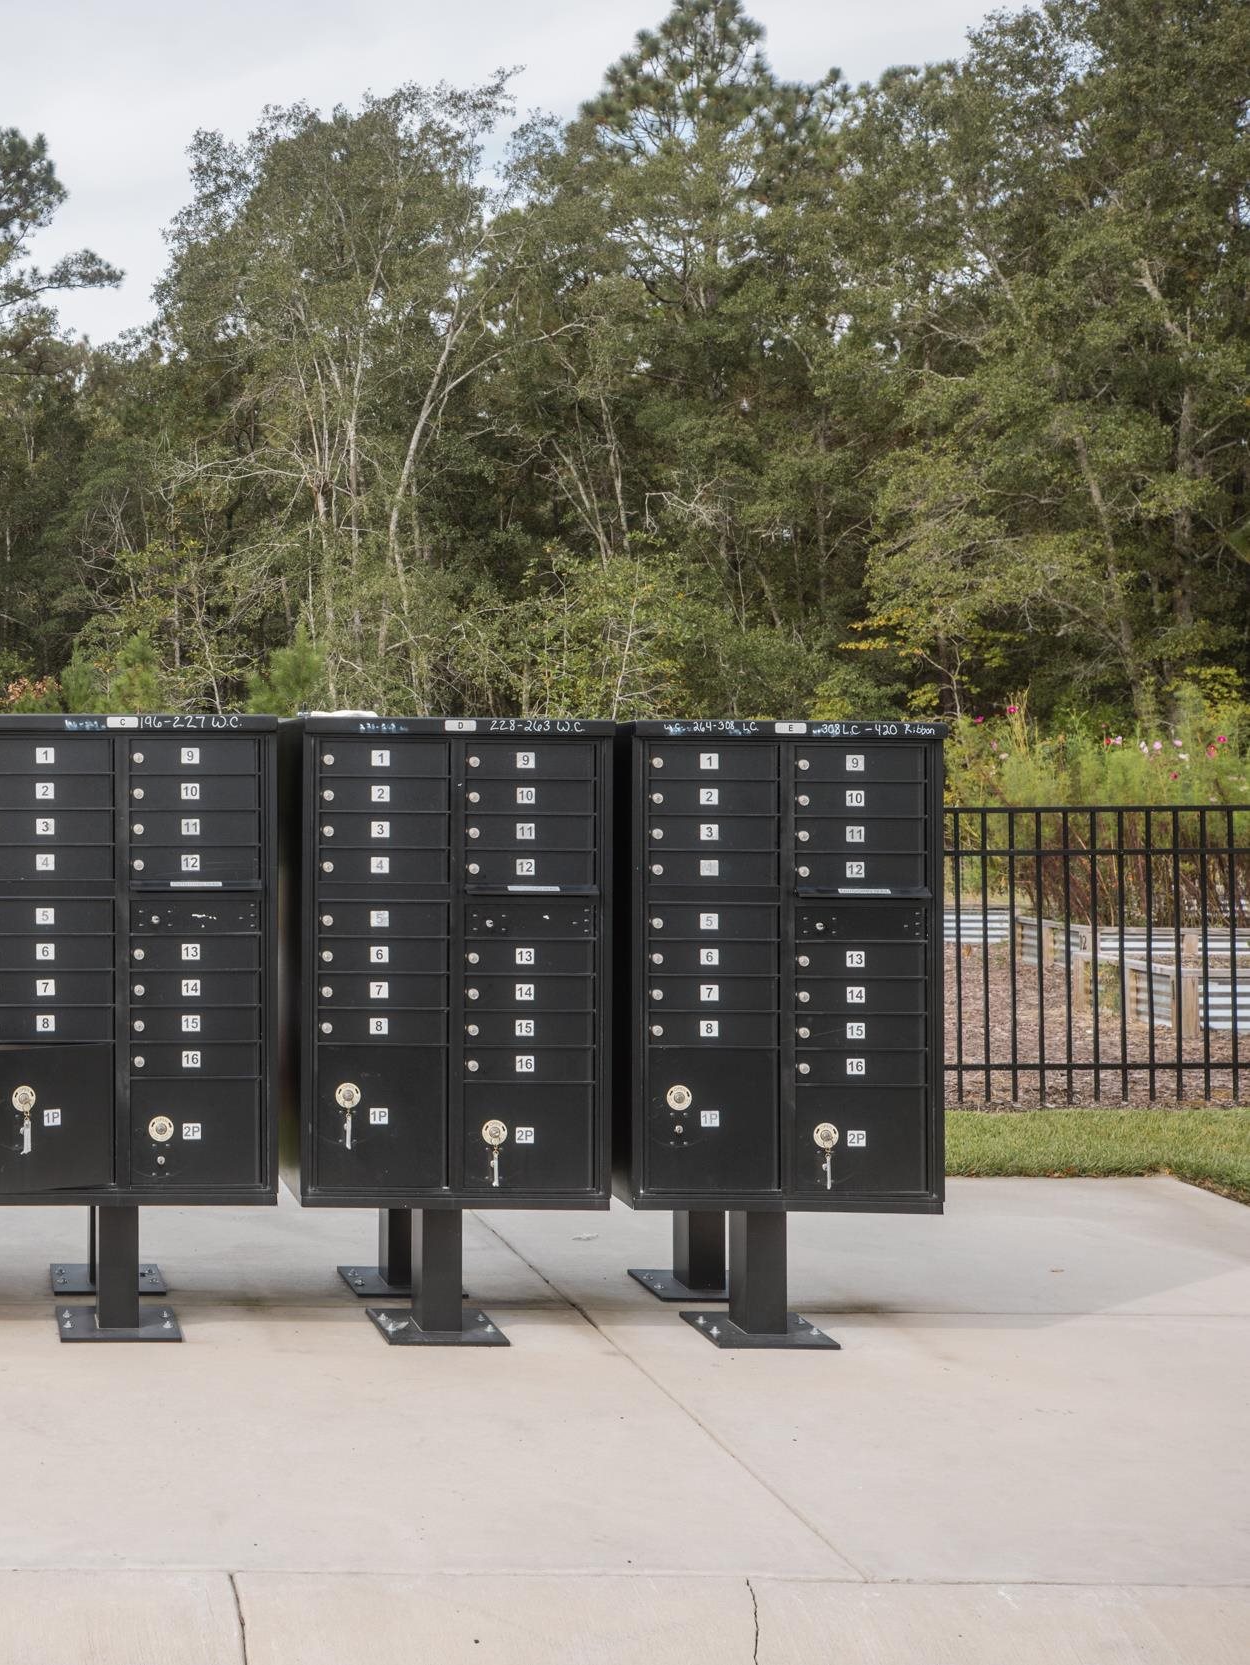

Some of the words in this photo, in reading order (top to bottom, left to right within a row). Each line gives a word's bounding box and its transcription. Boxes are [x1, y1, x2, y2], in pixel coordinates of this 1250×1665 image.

[119, 718, 126, 726] C
[140, 715, 206, 729] 196-227
[211, 715, 243, 728] W.C.
[457, 721, 464, 730] D
[490, 720, 551, 732] 228-263
[692, 721, 735, 732] 264-308
[788, 724, 794, 732] E
[904, 723, 936, 736] Ribbon
[186, 750, 194, 762] 9
[521, 754, 530, 766] 9
[851, 757, 859, 769] 9
[41, 785, 49, 797] 2
[182, 785, 198, 797] 10
[377, 787, 385, 800] 2
[518, 790, 534, 802] 10
[705, 790, 713, 802] 2
[847, 793, 863, 805] 10
[41, 820, 50, 833] 3
[184, 821, 199, 833] 11
[376, 823, 385, 835] 3
[519, 825, 534, 837] 11
[705, 826, 714, 838] 3
[848, 828, 863, 840] 11
[41, 856, 50, 868] 4
[182, 857, 198, 869] 12
[375, 859, 384, 871] 4
[517, 861, 533, 873] 12
[847, 864, 863, 876] 12
[41, 910, 50, 922] 5
[375, 913, 384, 925] 5
[705, 915, 714, 927] 5
[41, 945, 50, 958] 6
[183, 946, 199, 958] 13
[375, 948, 384, 961] 6
[517, 950, 533, 962] 13
[705, 951, 714, 963] 6
[847, 953, 863, 965] 13
[41, 981, 50, 993] 7
[183, 982, 199, 994] 14
[375, 984, 383, 996] 7
[517, 986, 533, 998] 14
[705, 987, 714, 999] 7
[848, 989, 864, 1001] 14
[41, 1017, 50, 1029] 8
[183, 1017, 199, 1029] 15
[375, 1020, 383, 1032] 8
[517, 1022, 533, 1034] 15
[705, 1022, 714, 1034] 8
[848, 1025, 864, 1037] 15
[183, 1053, 199, 1065] 16
[517, 1058, 533, 1070] 16
[848, 1061, 864, 1073] 16
[45, 1111, 61, 1124] 1P
[371, 1110, 387, 1122] 1P
[702, 1113, 718, 1125] 1P
[184, 1125, 201, 1137] 2P
[517, 1129, 534, 1141] 2P
[848, 1132, 865, 1144] 2P
